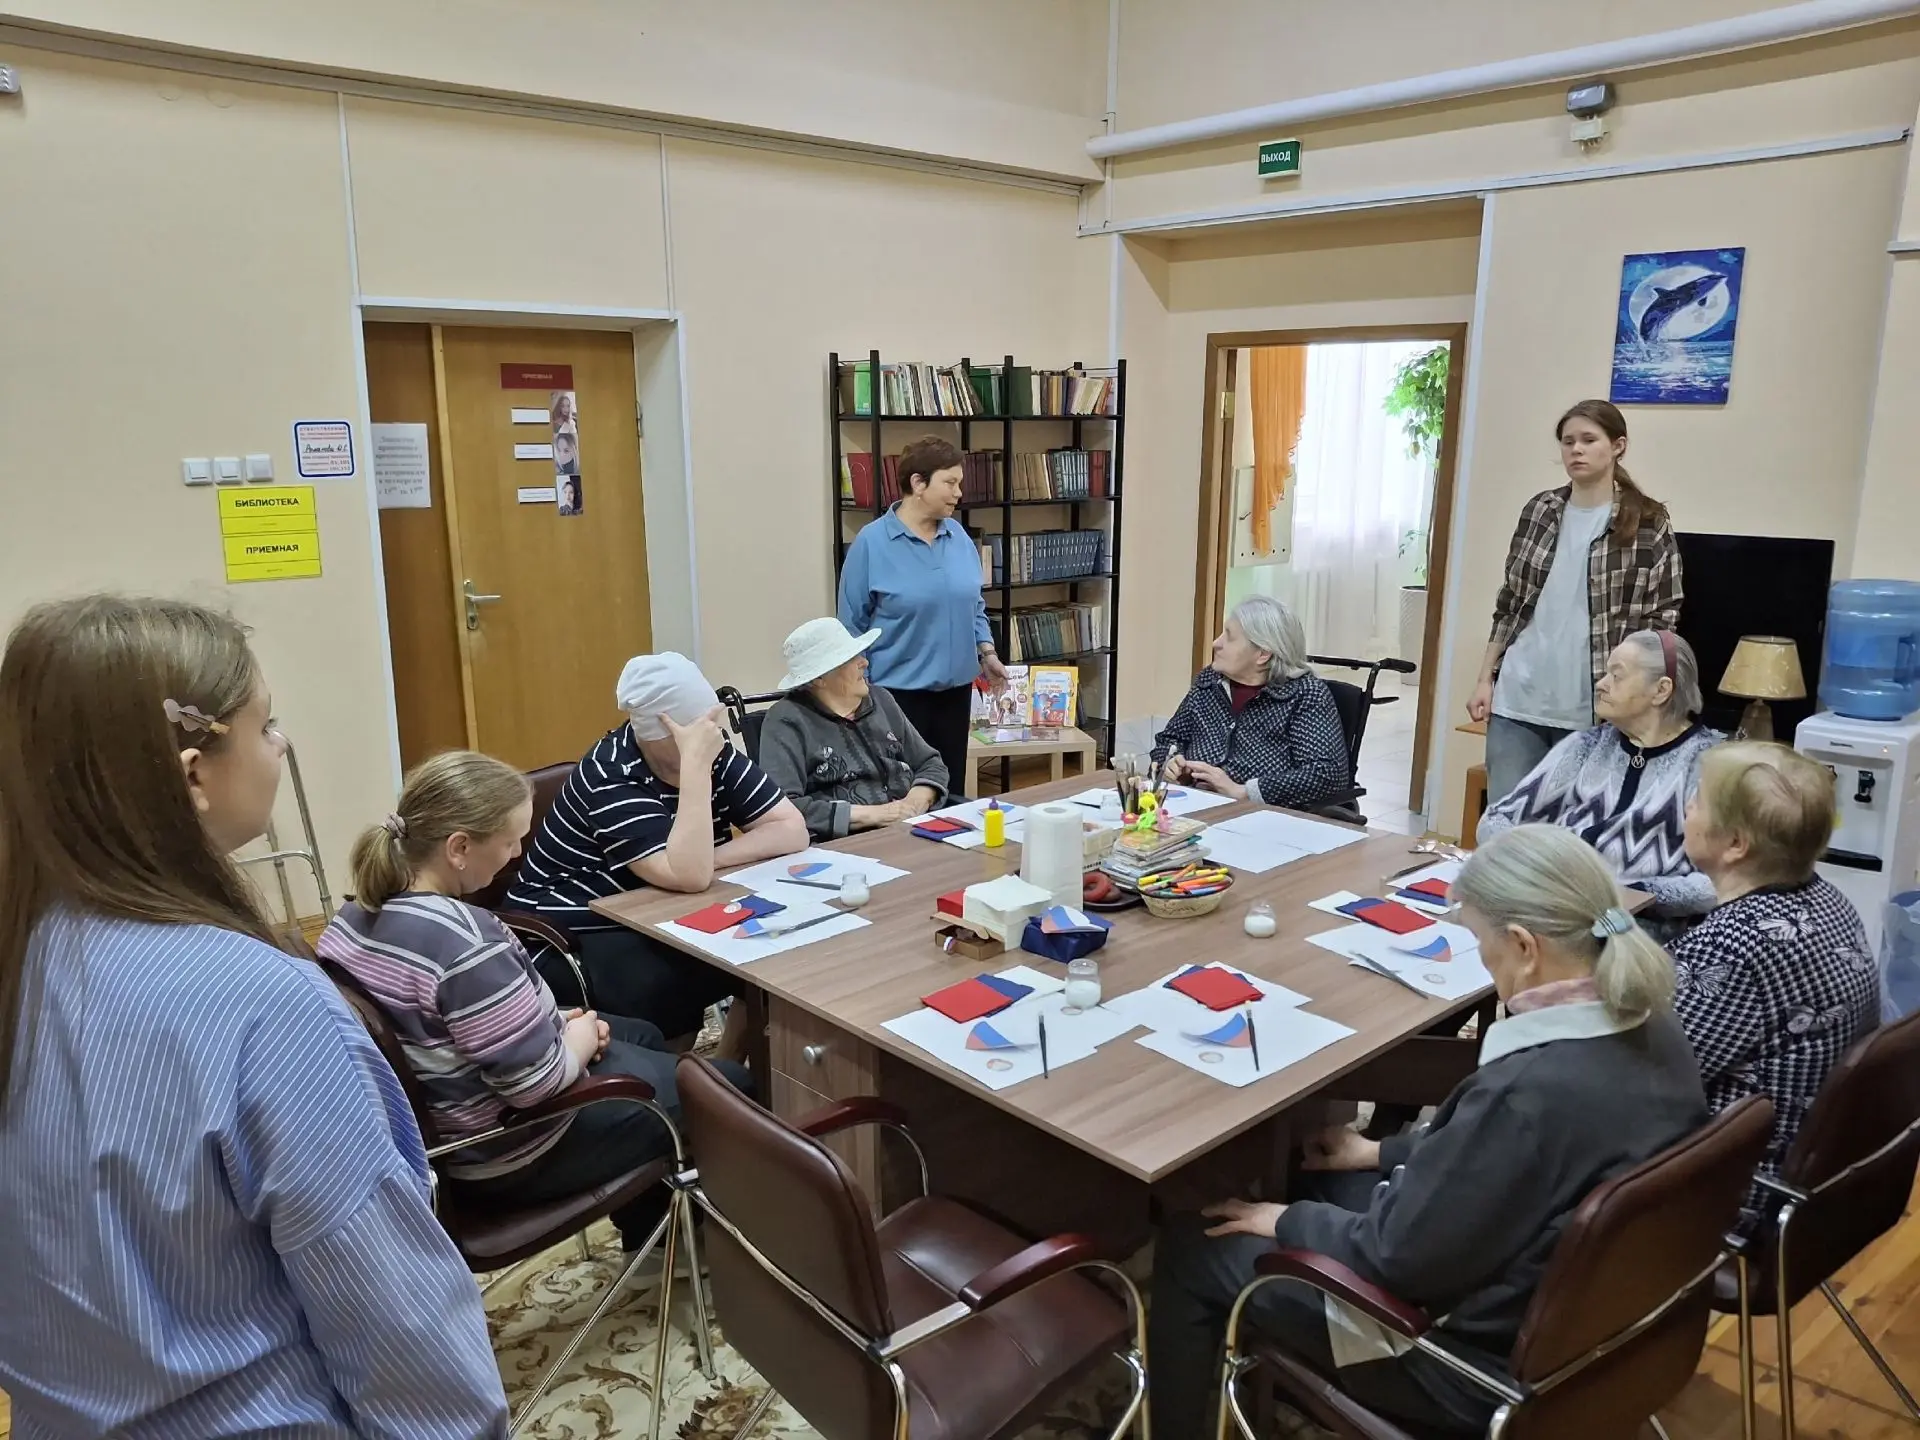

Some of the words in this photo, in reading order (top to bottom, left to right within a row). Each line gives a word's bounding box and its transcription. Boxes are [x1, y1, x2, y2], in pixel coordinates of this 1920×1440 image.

[1261, 151, 1291, 163] ВЫХОД
[235, 498, 299, 508] БИБЛИОТЕКА
[246, 544, 299, 554] ПРИЕМНАЯ
